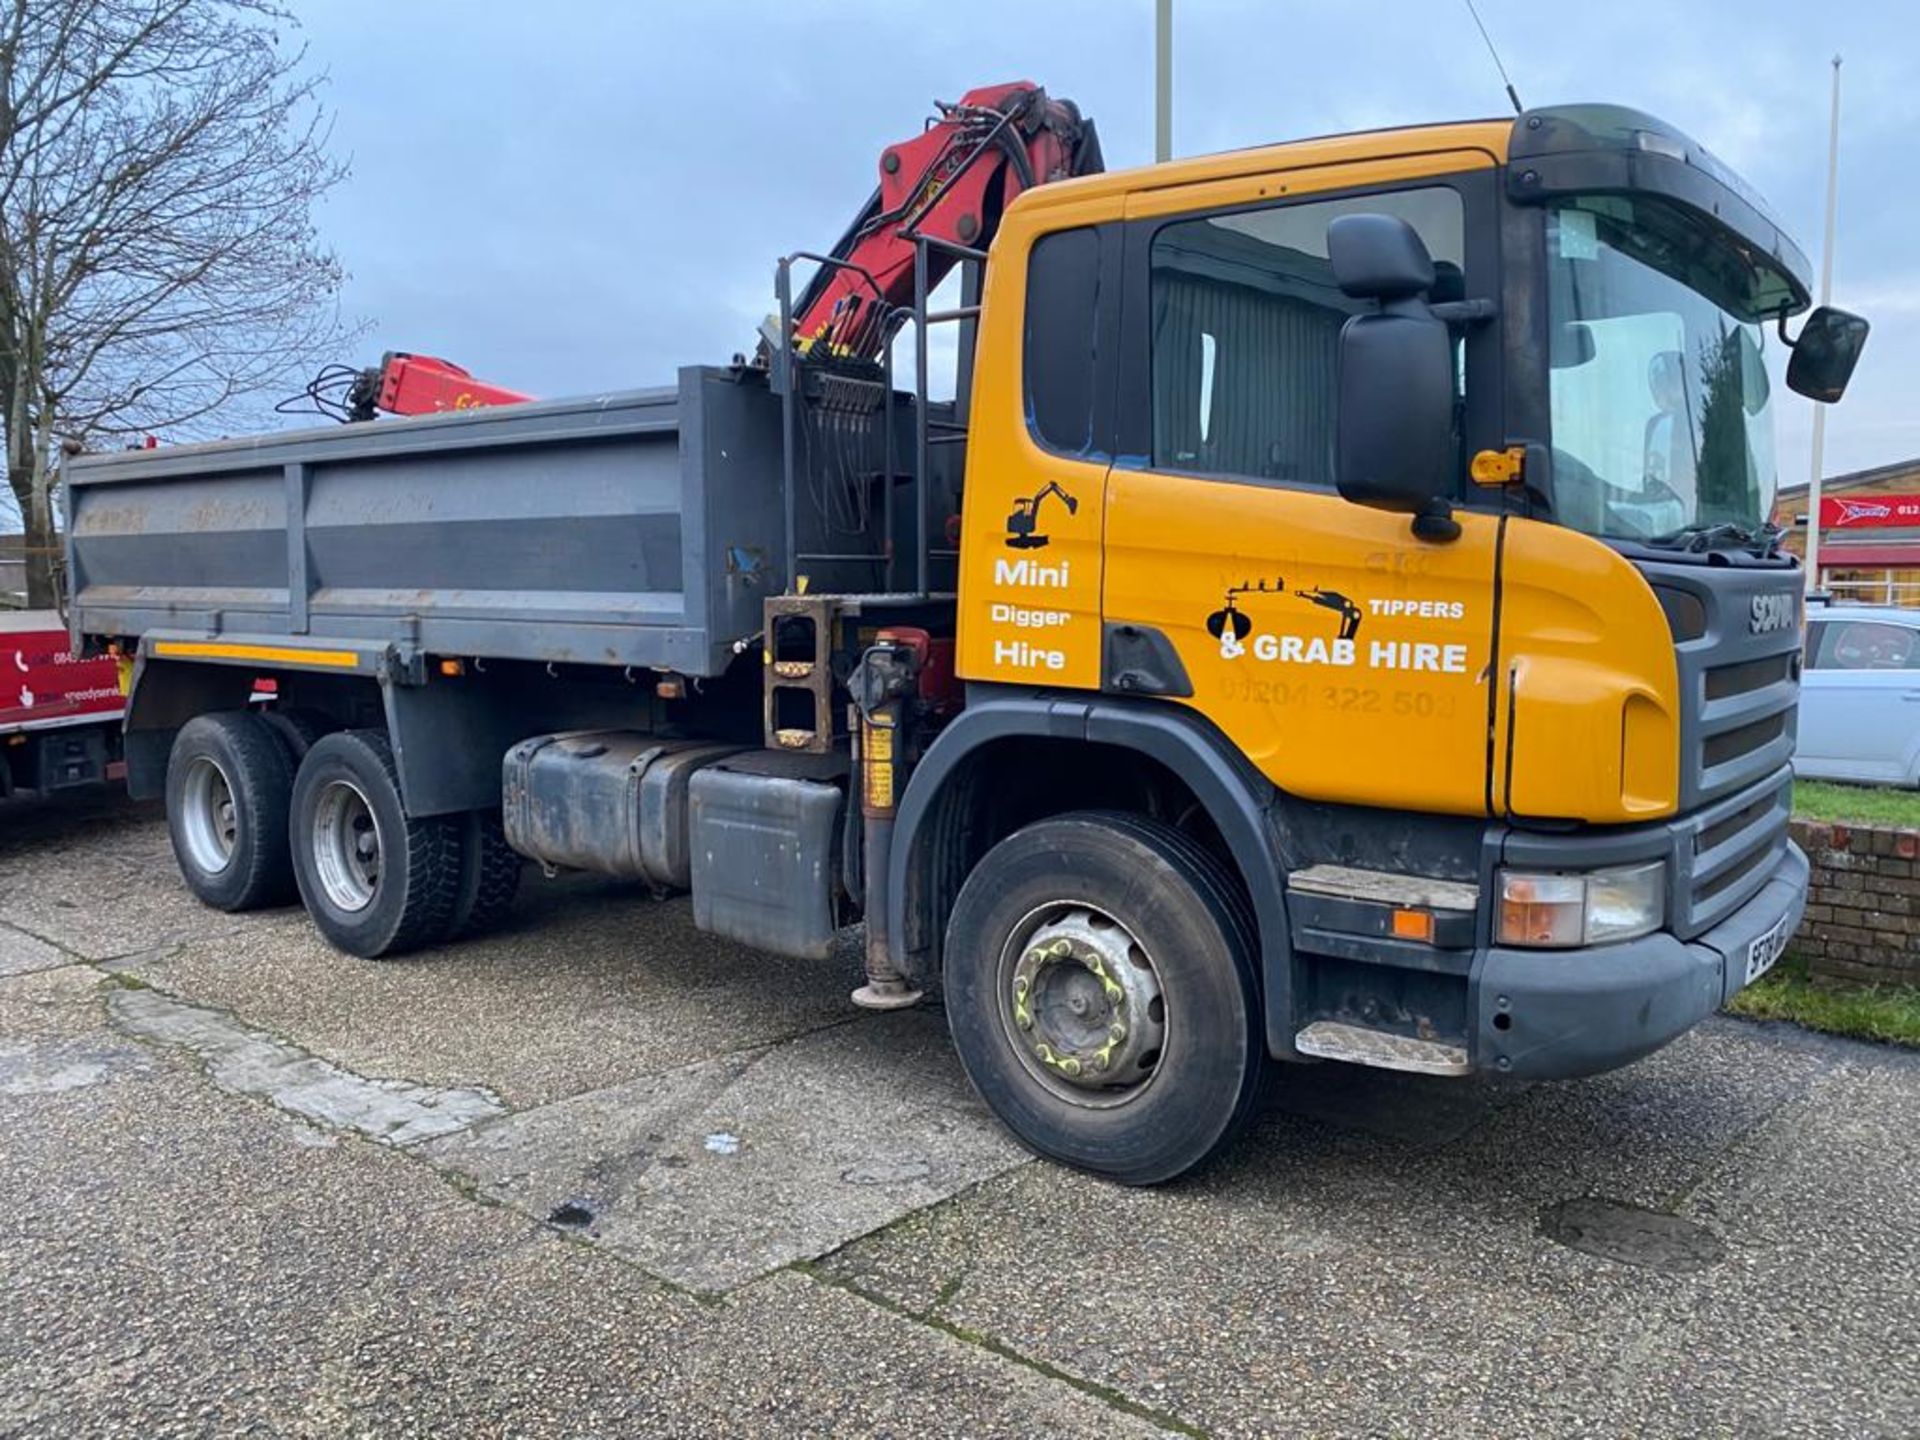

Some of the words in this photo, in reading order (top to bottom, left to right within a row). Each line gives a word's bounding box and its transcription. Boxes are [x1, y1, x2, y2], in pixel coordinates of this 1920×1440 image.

[995, 559, 1070, 588] Mini
[991, 603, 1071, 628] Digger
[1369, 599, 1464, 619] TIPPERS
[994, 639, 1066, 669] Hire
[1220, 631, 1246, 659] &
[1253, 634, 1356, 666] GRAB
[1369, 640, 1467, 673] HIRE
